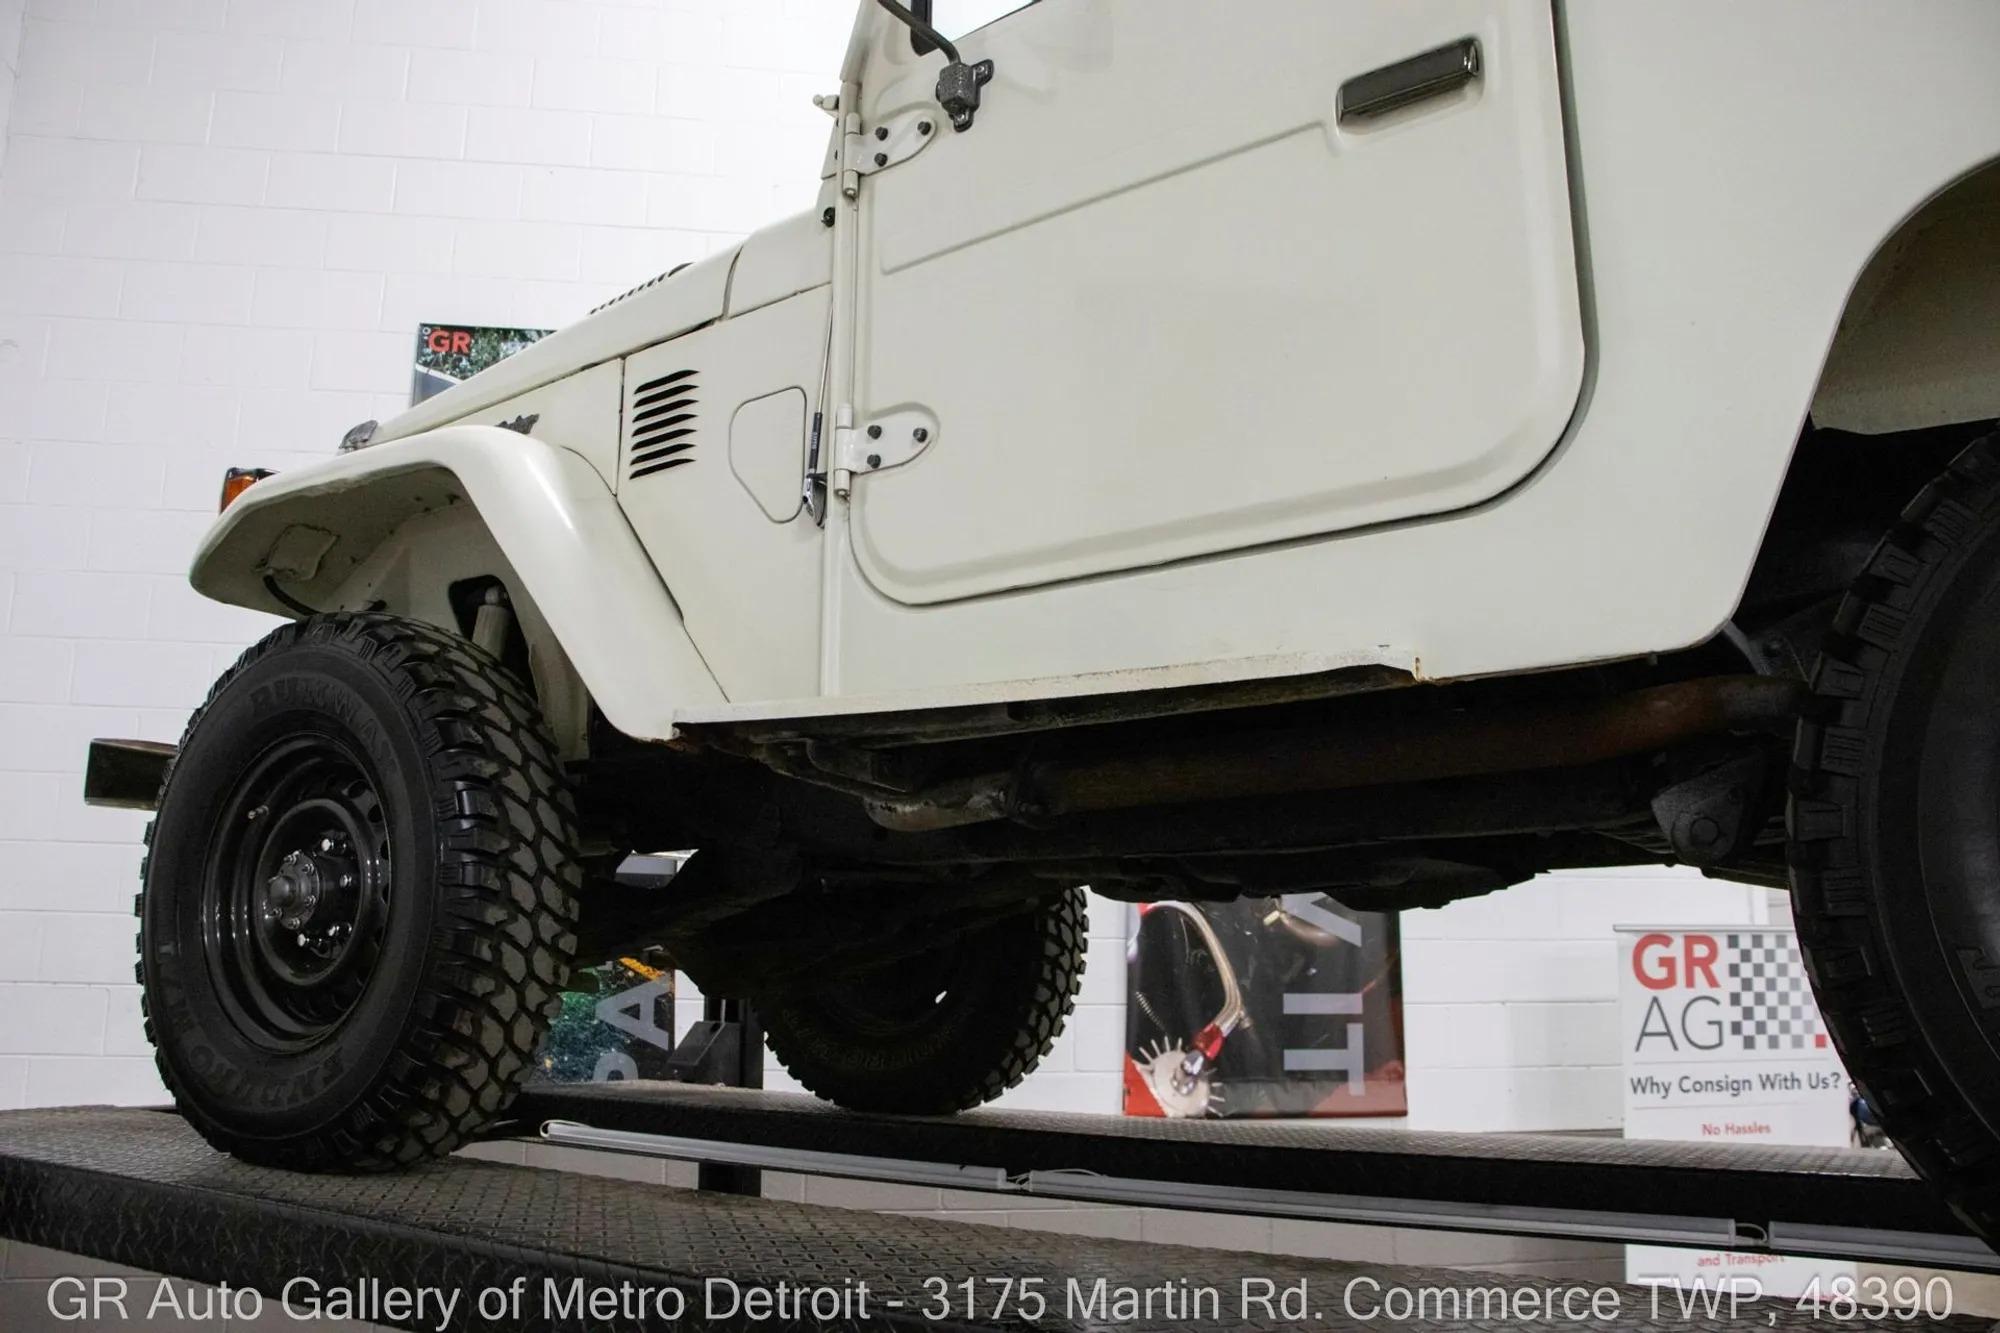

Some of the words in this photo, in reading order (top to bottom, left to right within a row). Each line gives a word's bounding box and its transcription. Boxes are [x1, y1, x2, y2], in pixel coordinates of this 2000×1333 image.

[428, 330, 471, 353] GR
[1632, 933, 1721, 990] GR
[1635, 995, 1724, 1052] AG
[1630, 1077, 1672, 1099] Why
[1678, 1075, 1752, 1097] Consign
[1759, 1073, 1802, 1091] With
[1808, 1072, 1842, 1089] Us?
[1702, 1124, 1721, 1136] No
[1697, 1253, 1721, 1267] and
